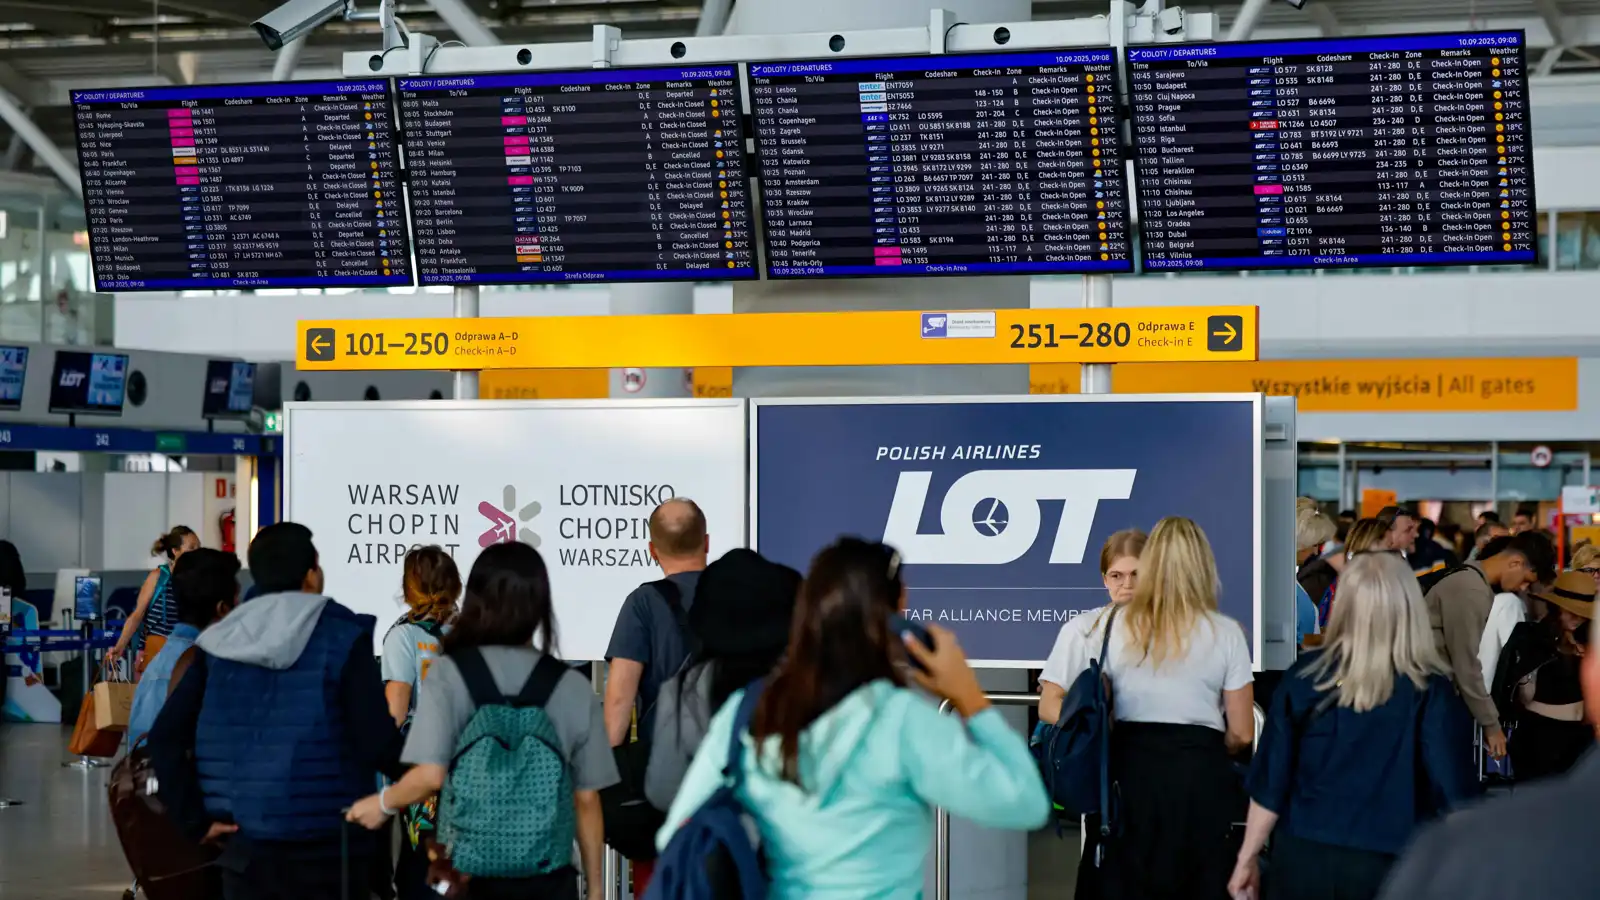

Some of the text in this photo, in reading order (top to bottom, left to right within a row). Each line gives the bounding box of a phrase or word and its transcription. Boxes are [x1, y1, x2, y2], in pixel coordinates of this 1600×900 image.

[1497, 36, 1517, 44] 09:08
[1141, 50, 1167, 58] ODLOTY
[1173, 48, 1216, 56] DEPARTURES
[1263, 57, 1283, 65] Flight
[1317, 54, 1352, 62] Codeshare
[1369, 52, 1399, 60] Check-In
[1489, 47, 1519, 55] Weather
[792, 64, 832, 72] DEPARTURES
[875, 73, 894, 81] Flight
[1155, 71, 1185, 79] Sarajewo
[1156, 82, 1187, 90] Budapest
[514, 87, 532, 95] Flight
[1157, 93, 1170, 101] Cluj
[1136, 104, 1181, 112] 10:50 Prague
[779, 117, 816, 125] Copenhagen
[1158, 114, 1175, 122] Sofia
[780, 128, 801, 136] Zagreb
[1159, 124, 1186, 132] Istanbul
[781, 137, 807, 145] Brussels
[1160, 136, 1175, 144] Riga
[1163, 167, 1195, 175] Heraklion
[1164, 188, 1192, 196] Chisinau
[1165, 199, 1195, 207] Ljubljana
[1178, 209, 1205, 218] Angeles
[1168, 230, 1187, 238] Dubai
[790, 239, 821, 247] Podgorica
[1169, 241, 1194, 249] Belgrad
[1169, 251, 1192, 259] Vilnius
[1138, 321, 1195, 333] Odprawa E
[455, 333, 495, 342] Odprawa
[1011, 323, 1130, 348] 251–280
[346, 333, 448, 355] 101–250
[1138, 336, 1193, 347] Check-in E
[455, 346, 494, 355] Check-in
[1251, 377, 1351, 397] Wszystkie
[1357, 376, 1431, 398] wyjścia
[1448, 375, 1474, 393] All
[1482, 378, 1535, 398] gates
[876, 445, 1041, 460] POLISH AIRLINES
[348, 484, 459, 505] WARSAW
[560, 485, 675, 506] LOTNISKO
[881, 469, 1137, 564] LOT
[348, 514, 459, 534] CHOPIN
[348, 544, 460, 564] AIRPT
[902, 609, 933, 620] TAR
[939, 610, 1021, 621] ALLIANCE
